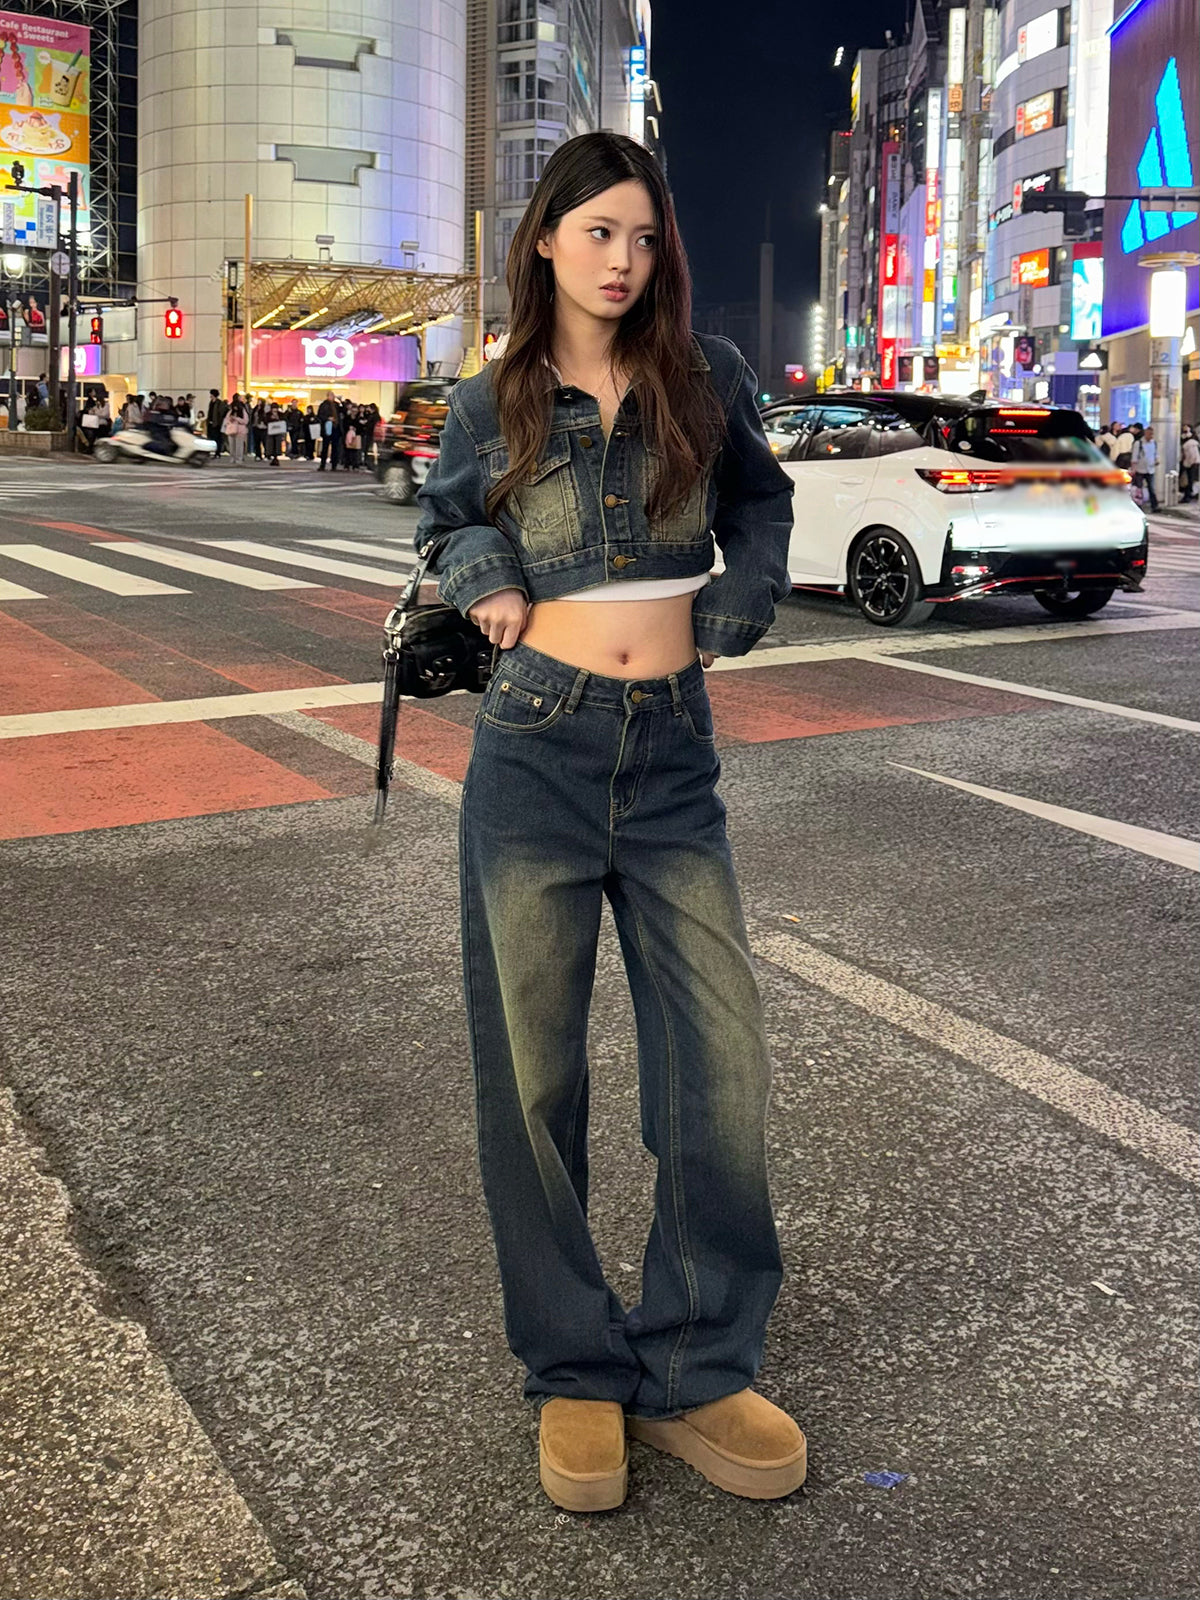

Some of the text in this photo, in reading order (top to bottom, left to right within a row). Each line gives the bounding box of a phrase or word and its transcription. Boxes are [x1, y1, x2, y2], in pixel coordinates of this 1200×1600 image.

[22, 23, 70, 39] Restaurant
[23, 31, 55, 43] Sweets
[301, 337, 354, 377] 109
